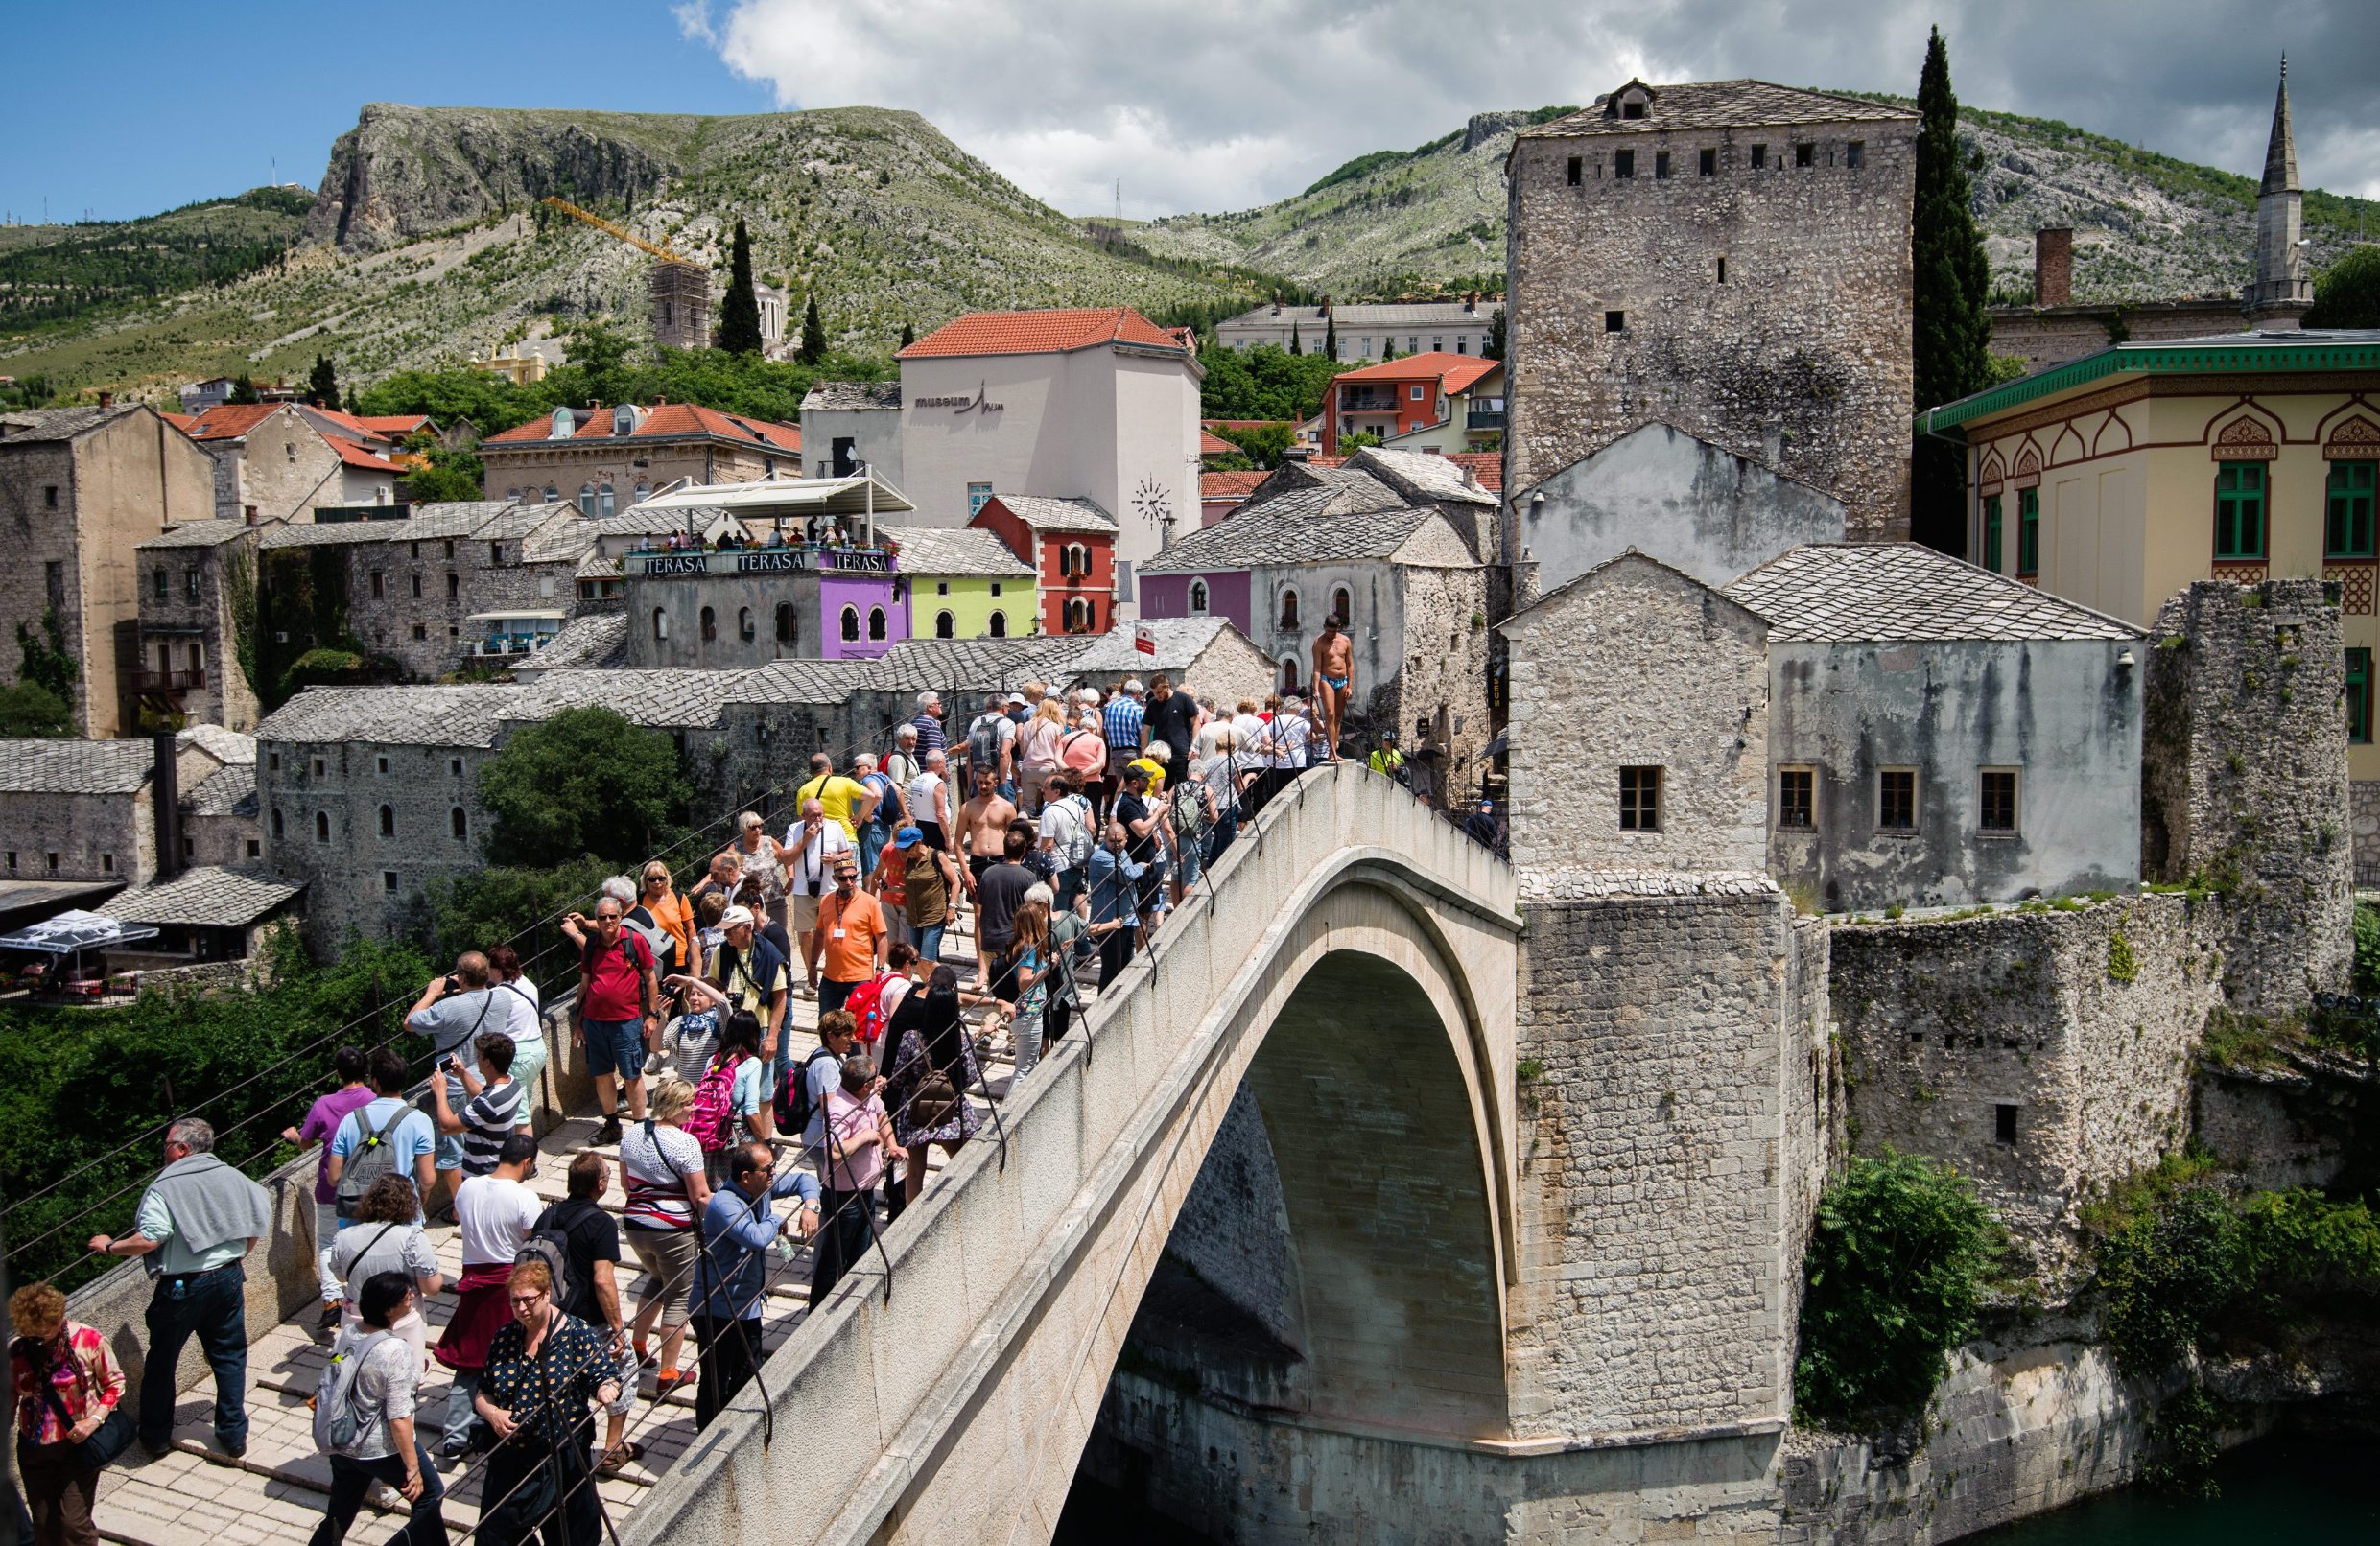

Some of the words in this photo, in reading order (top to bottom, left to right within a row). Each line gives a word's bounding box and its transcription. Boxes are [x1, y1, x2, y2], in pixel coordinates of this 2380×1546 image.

[915, 396, 970, 408] museum
[646, 557, 705, 573] TERASA
[739, 553, 804, 571] TERASA
[835, 553, 887, 571] TERASA
